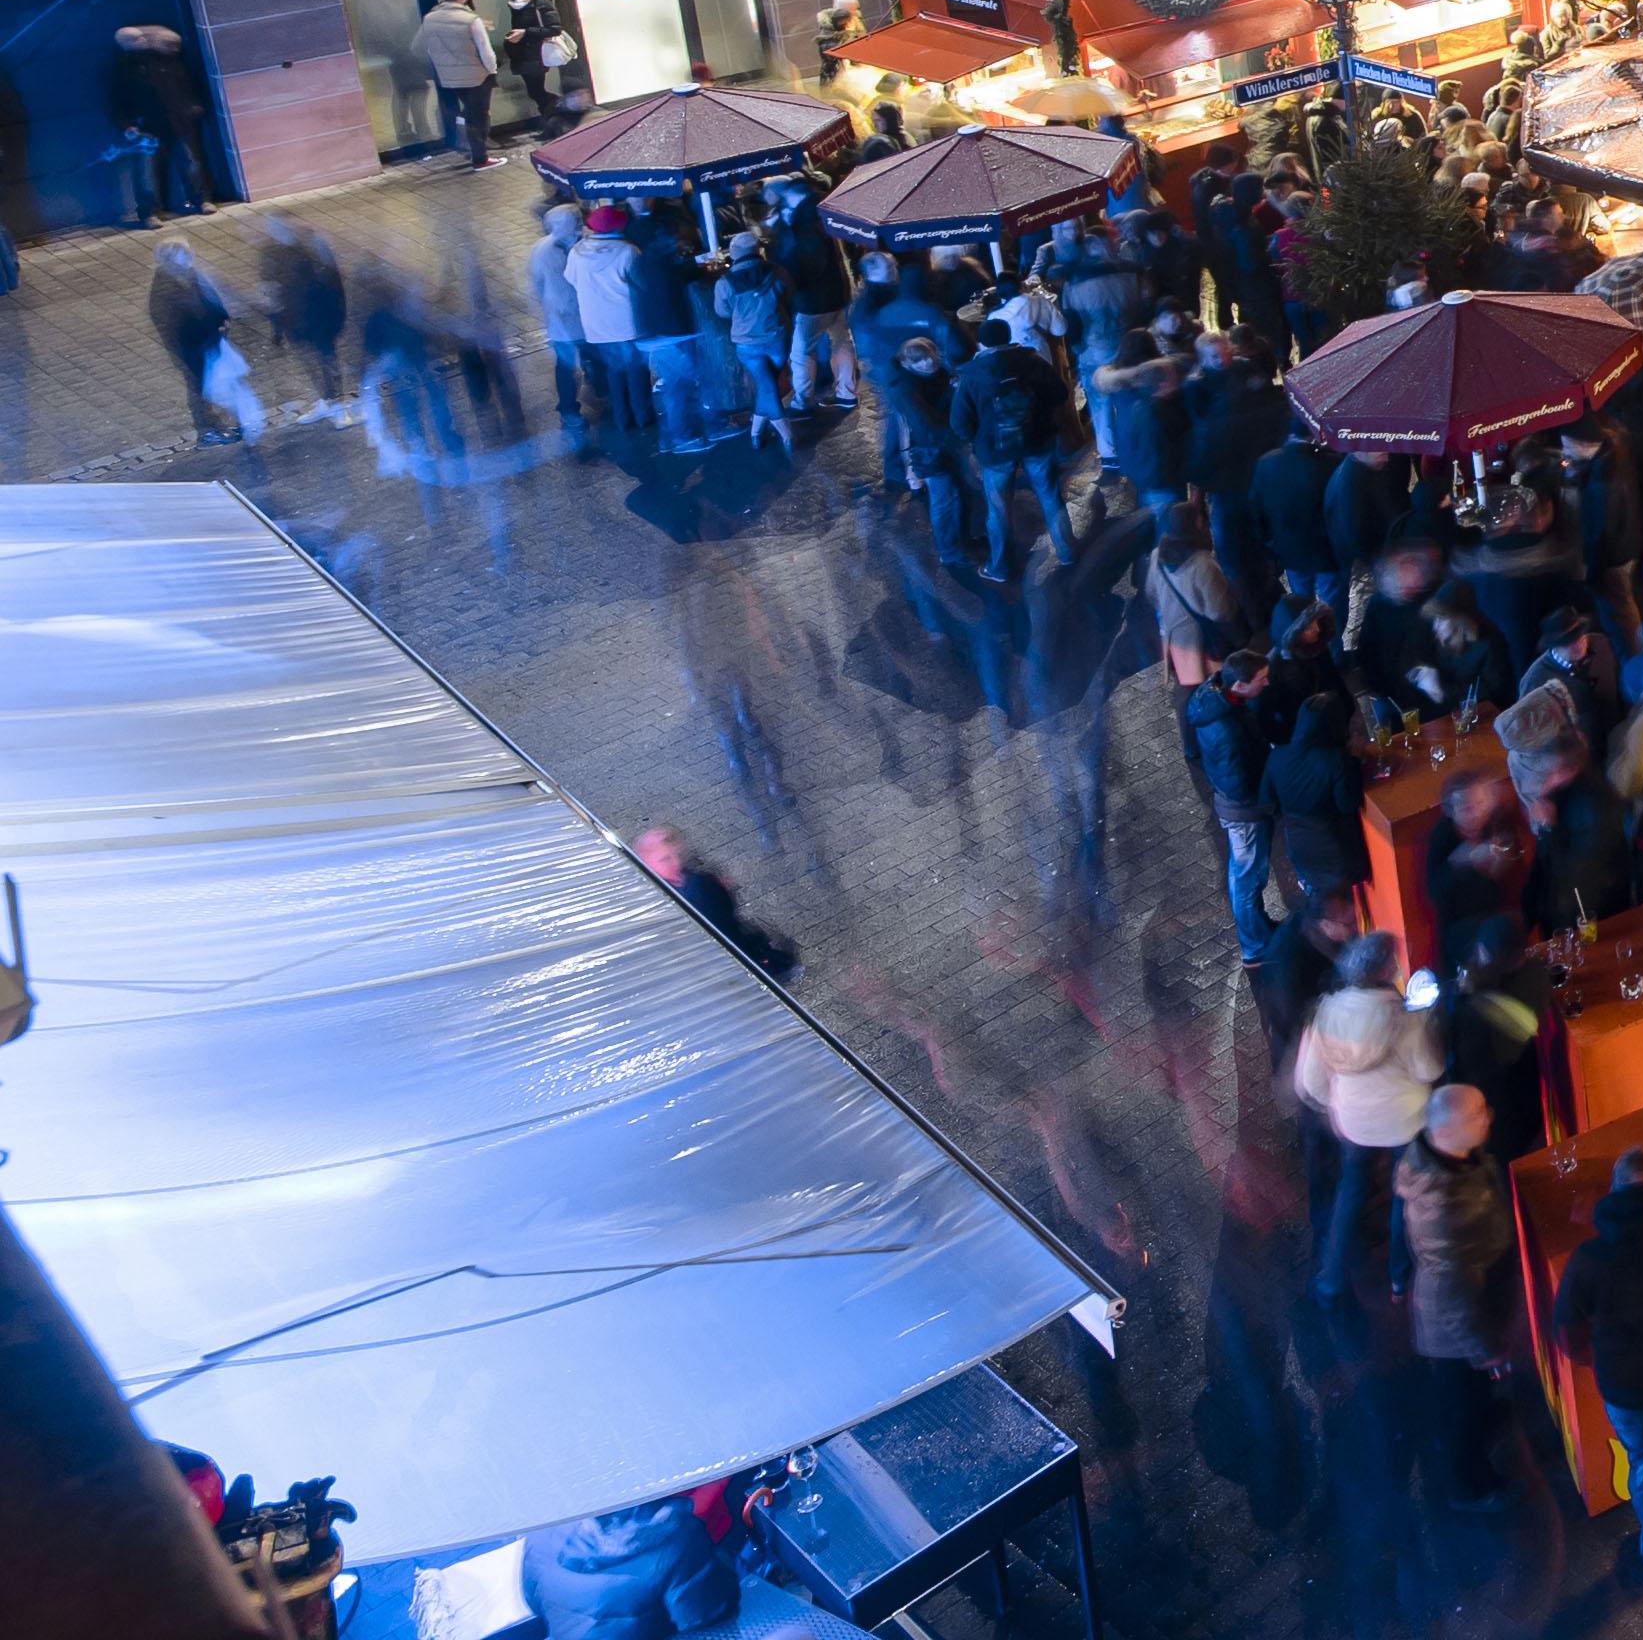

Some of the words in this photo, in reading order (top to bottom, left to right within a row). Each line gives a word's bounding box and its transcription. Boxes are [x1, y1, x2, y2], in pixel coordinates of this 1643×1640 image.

[1245, 66, 1331, 98] Winklerstraße
[1354, 63, 1381, 82] Zwischen
[1381, 72, 1391, 84] den
[1467, 398, 1575, 439] Feuerzangenbowle
[1337, 428, 1441, 443] Feuerzangenbowle
